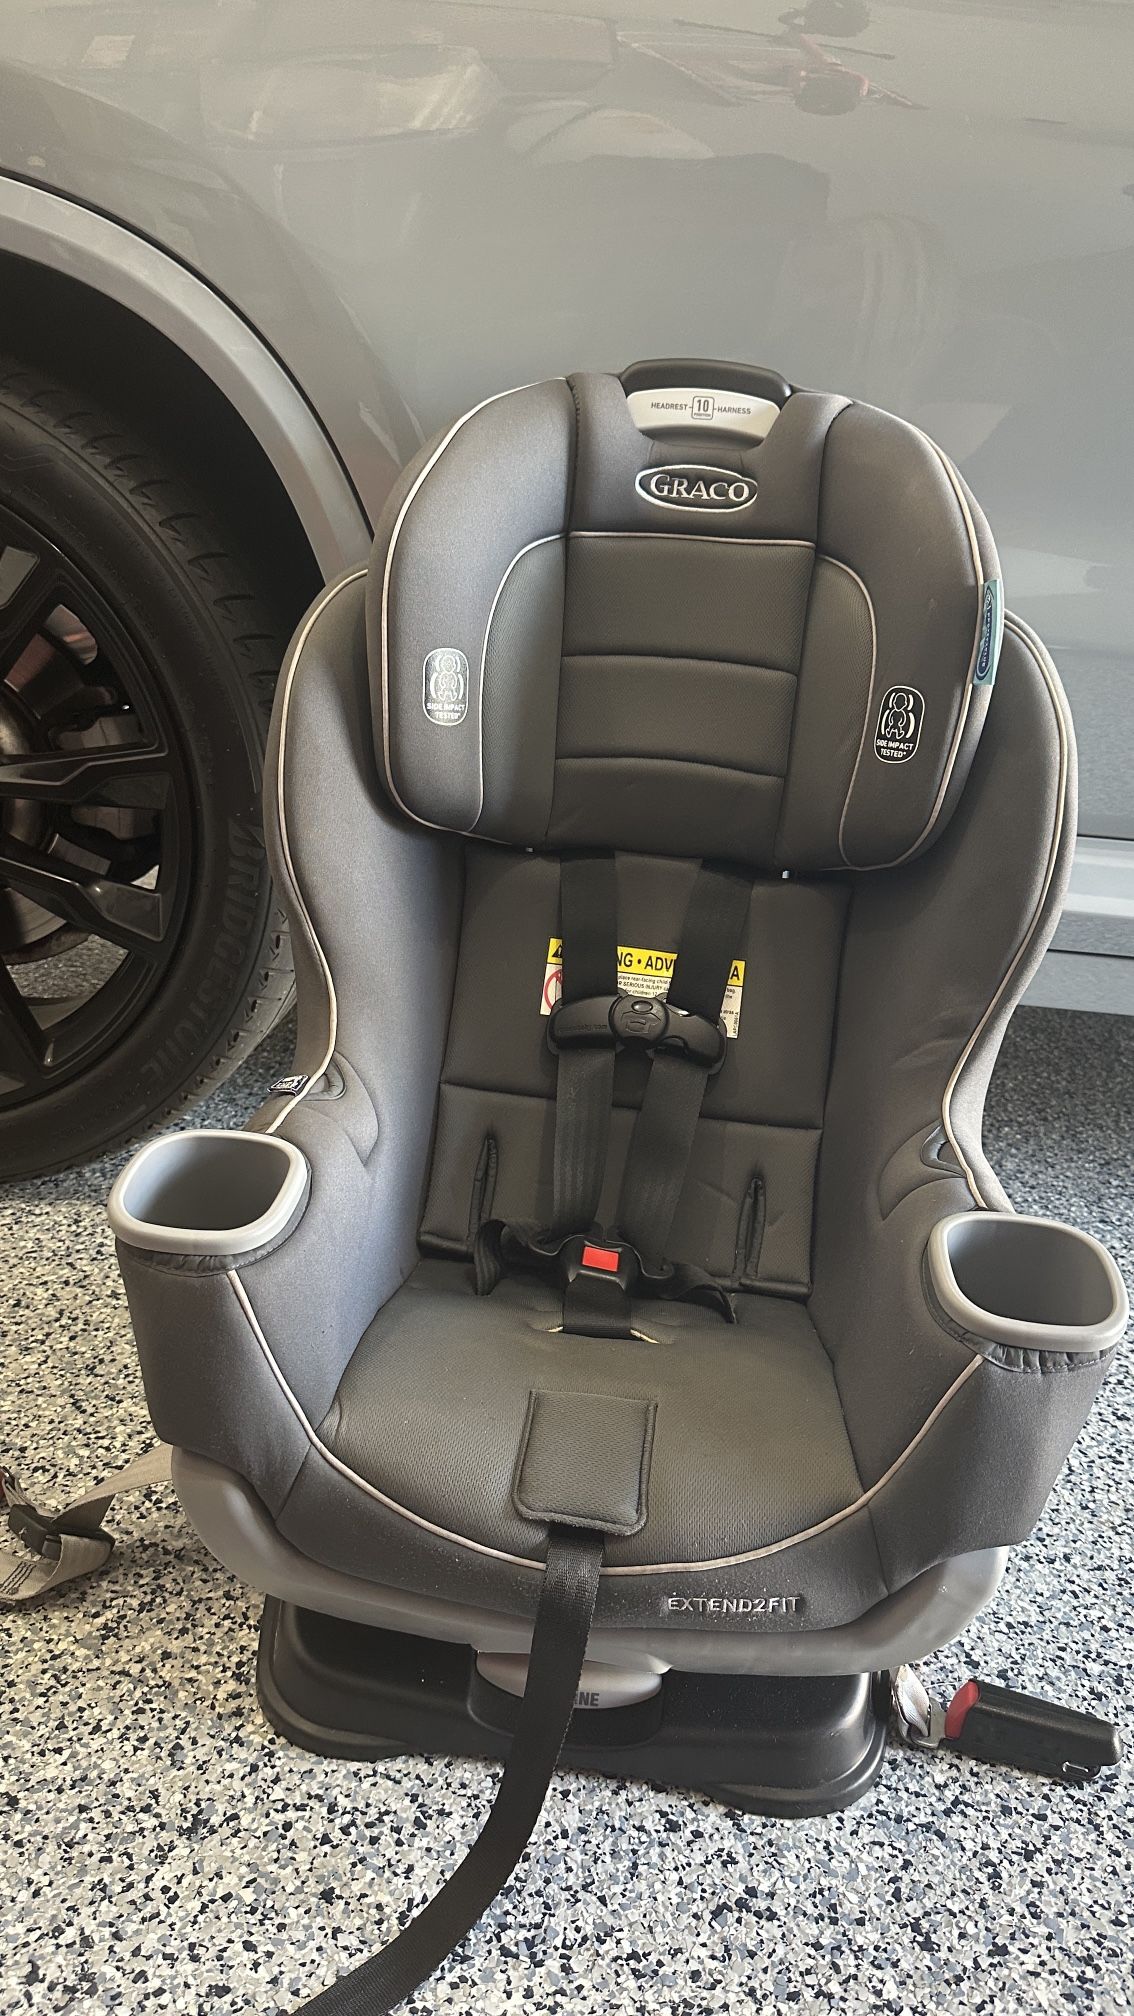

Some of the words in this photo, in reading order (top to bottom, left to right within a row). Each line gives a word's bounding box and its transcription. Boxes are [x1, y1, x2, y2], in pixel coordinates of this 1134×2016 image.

[651, 402, 688, 411] HEADREST
[697, 399, 709, 412] 10
[718, 407, 752, 416] HARNESS
[651, 474, 749, 501] GRACO
[877, 739, 888, 747] SIDE
[888, 741, 913, 750] IMPACT
[667, 1596, 800, 1613] EXTEND2FIT
